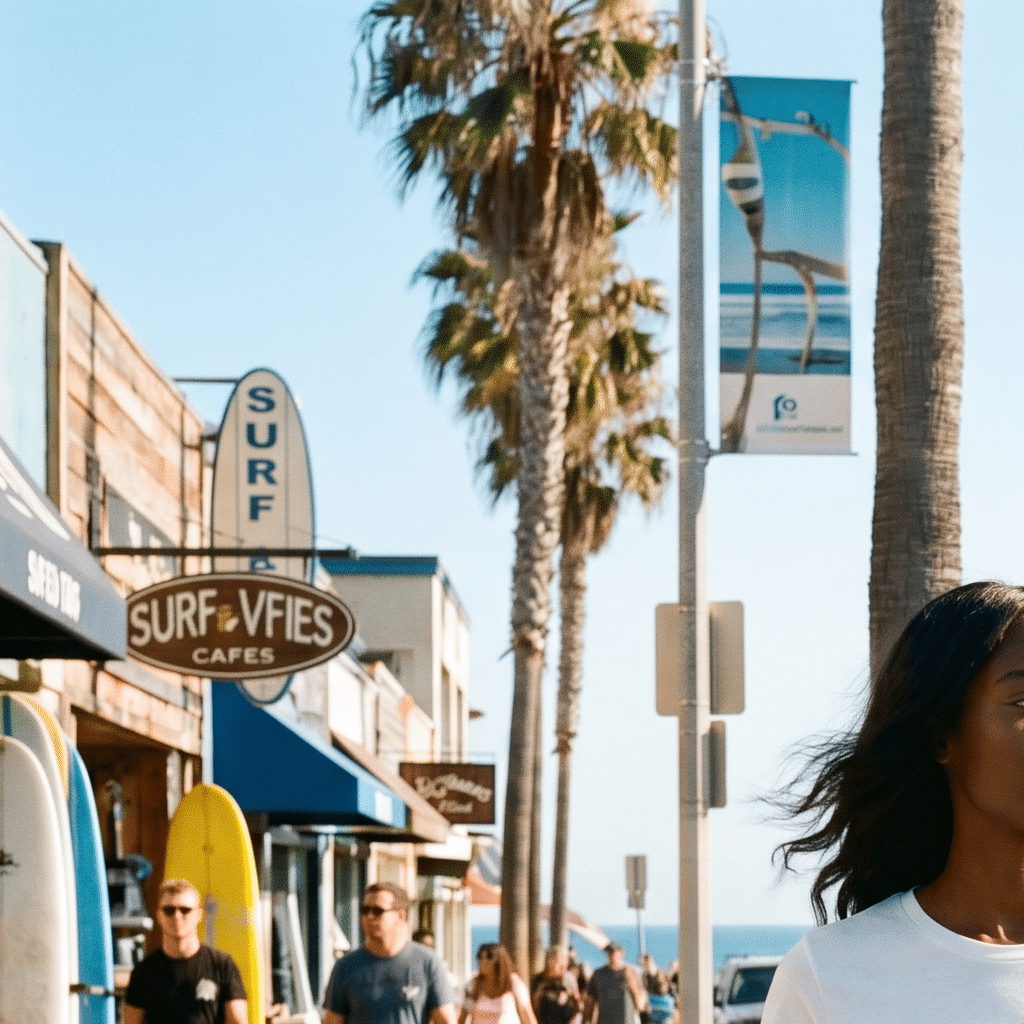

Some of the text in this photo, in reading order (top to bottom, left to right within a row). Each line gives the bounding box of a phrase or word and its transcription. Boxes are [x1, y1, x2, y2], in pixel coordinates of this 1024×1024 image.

[246, 386, 277, 521] SURF
[130, 588, 335, 647] SURF VFIES
[192, 647, 275, 664] CAFES
